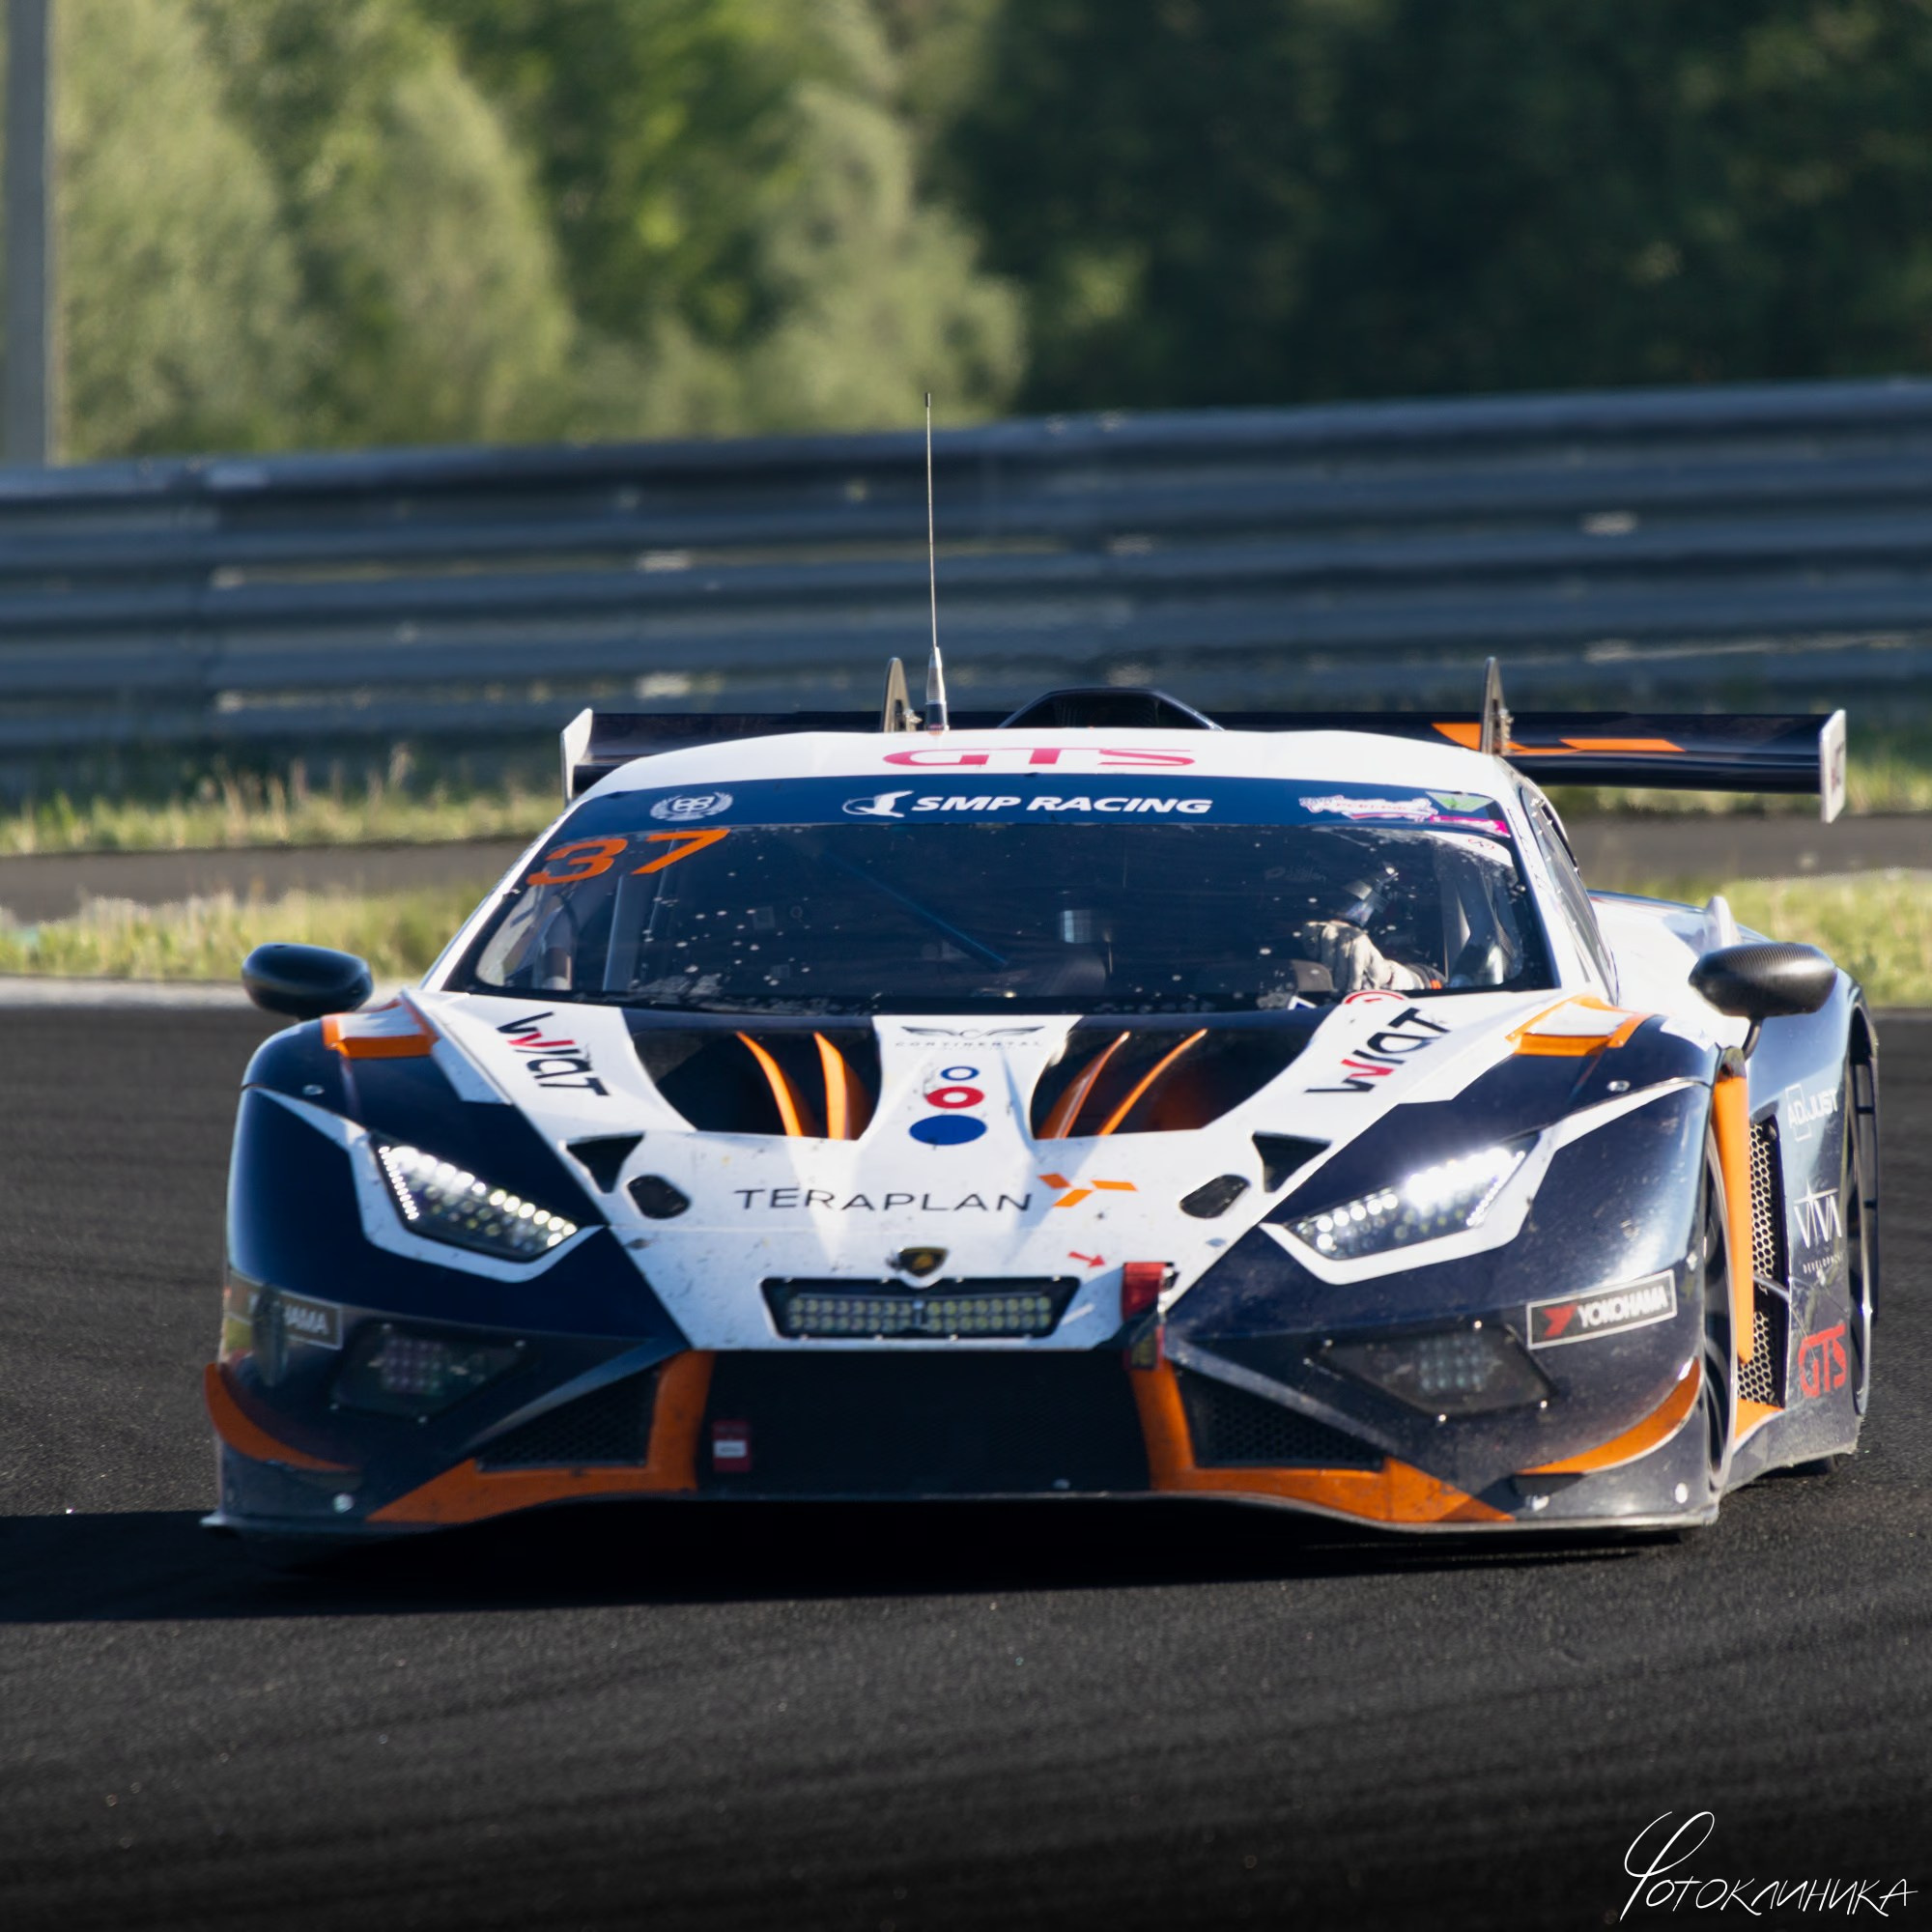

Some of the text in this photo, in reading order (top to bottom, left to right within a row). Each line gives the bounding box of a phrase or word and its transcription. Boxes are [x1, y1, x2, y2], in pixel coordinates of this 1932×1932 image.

[883, 748, 1196, 766] GTS
[911, 796, 1213, 813] SMP RACING
[526, 828, 731, 885] 37
[733, 1188, 1033, 1211] TERAPLAN
[1577, 1285, 1669, 1328] YOKOHAMA
[1798, 1322, 1848, 1399] GTS
